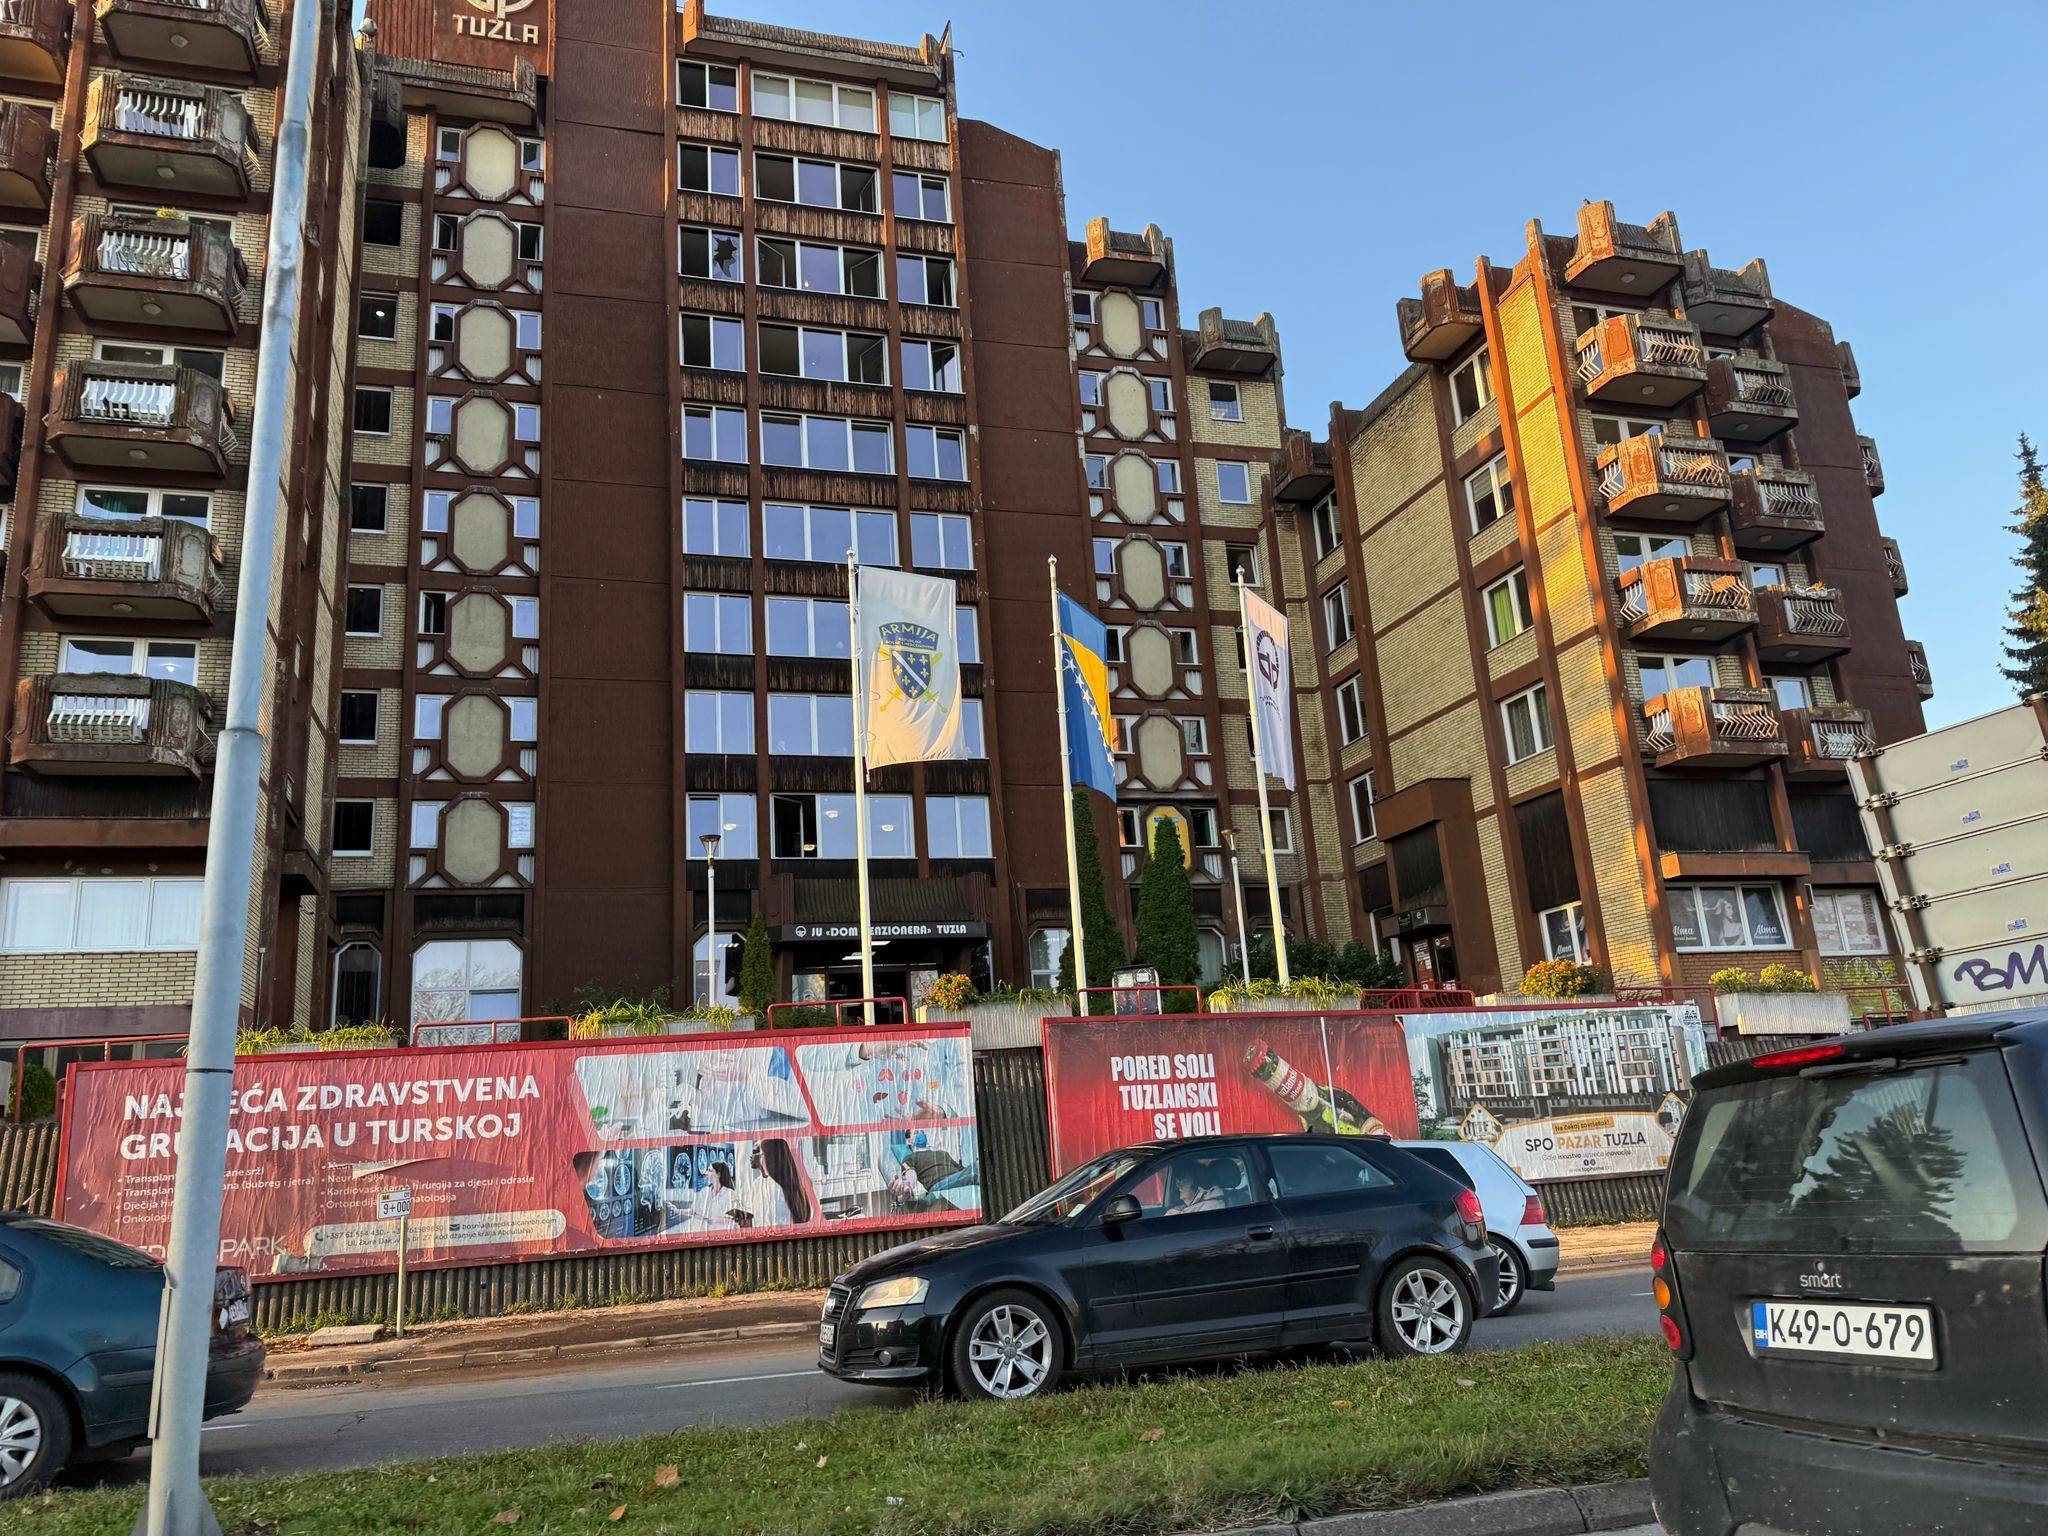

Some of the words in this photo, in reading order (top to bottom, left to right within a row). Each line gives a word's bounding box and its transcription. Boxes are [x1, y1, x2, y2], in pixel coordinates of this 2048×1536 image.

[452, 14, 539, 45] TUZLA
[881, 623, 937, 642] ARMIJA
[811, 928, 823, 937] JU
[868, 925, 932, 936] ENZIONERA»
[936, 924, 967, 934] TUZLA
[1111, 1055, 1171, 1081] PORED
[1175, 1053, 1215, 1079] SOLI
[296, 1074, 540, 1111] ZDRAVSTVENA
[1119, 1082, 1218, 1111] TUZLANSKI
[120, 1124, 324, 1160] GRACIJA
[334, 1122, 356, 1148] U
[366, 1112, 521, 1146] TURSKOJ
[1154, 1114, 1178, 1140] SE
[1180, 1111, 1221, 1137] VOLI
[1525, 1137, 1554, 1153] SPO
[1557, 1134, 1601, 1150] PAZAR
[1604, 1131, 1647, 1147] TUZLA
[1800, 1272, 1842, 1289] smart
